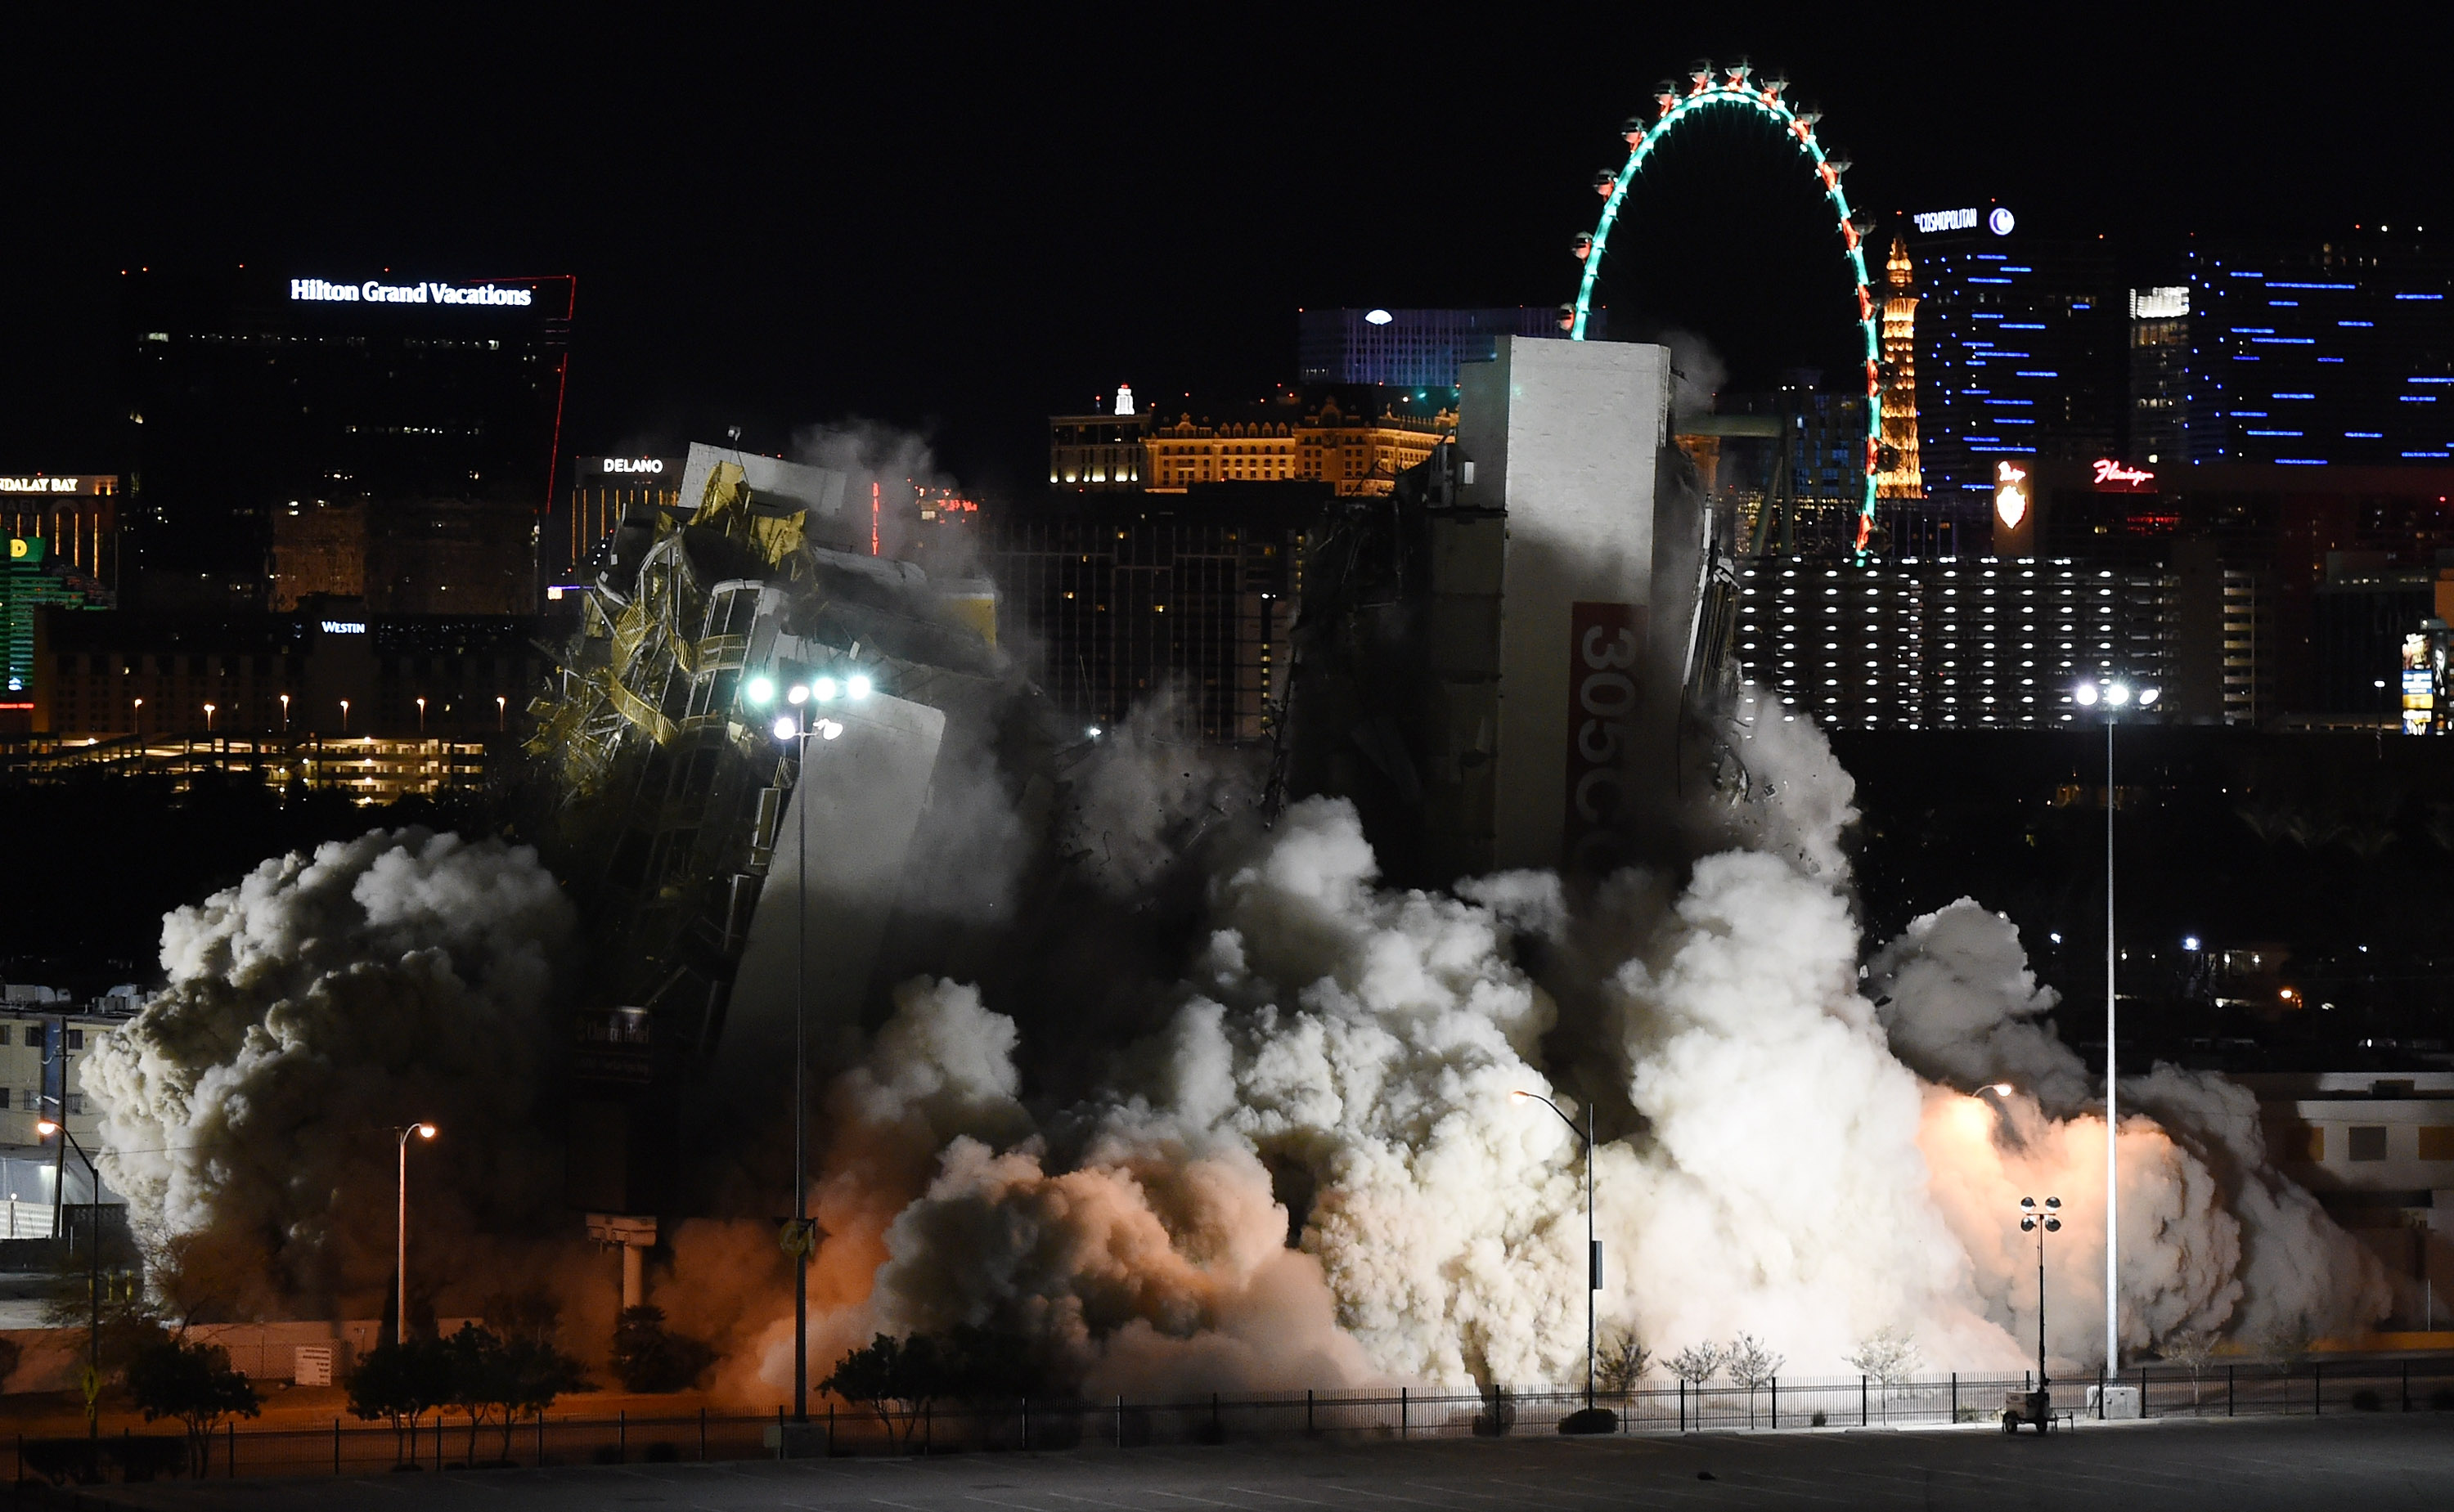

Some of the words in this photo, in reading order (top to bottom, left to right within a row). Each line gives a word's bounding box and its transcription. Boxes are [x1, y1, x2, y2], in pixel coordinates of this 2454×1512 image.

[1919, 208, 1977, 233] COSMOPOLITAN
[290, 279, 360, 301] Hilton
[362, 281, 428, 303] Grand
[429, 283, 532, 306] Vacations
[603, 459, 663, 473] DELANO
[2092, 459, 2155, 487] Flamingo
[51, 478, 79, 492] BAY
[321, 621, 366, 634] WESTIN
